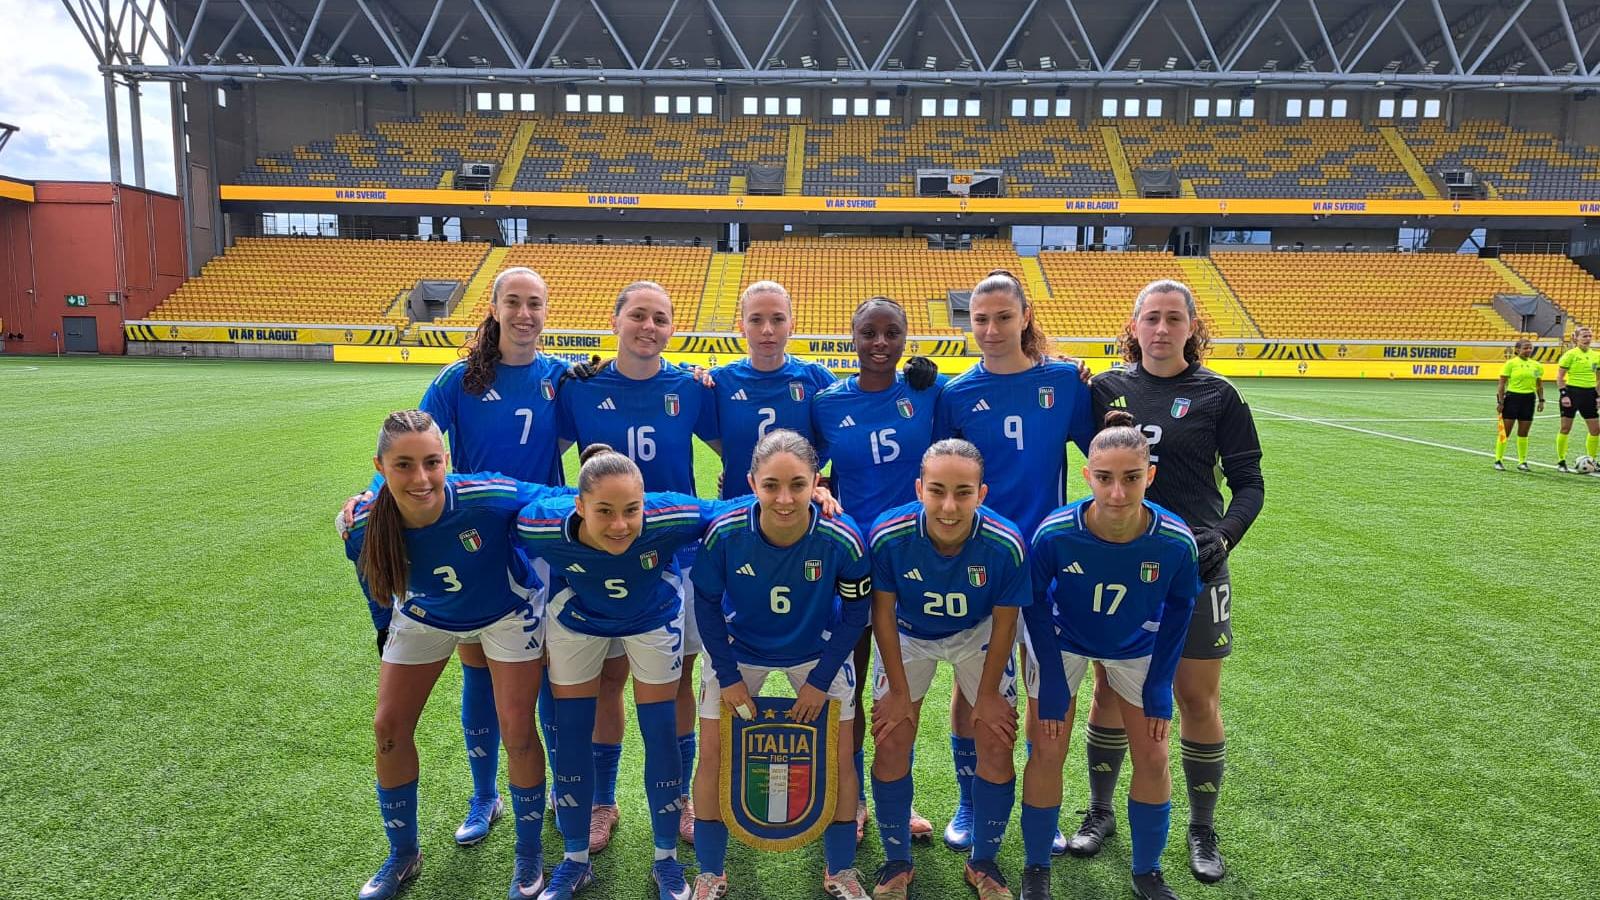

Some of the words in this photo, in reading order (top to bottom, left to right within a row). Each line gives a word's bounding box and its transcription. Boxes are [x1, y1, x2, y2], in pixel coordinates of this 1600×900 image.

[356, 190, 387, 200] SVERIGE
[846, 199, 877, 209] SVERIGE
[1334, 202, 1366, 211] SVERIGE
[228, 328, 239, 340] VI
[557, 336, 601, 348] SVERIGE!
[809, 341, 819, 352] VI
[1104, 344, 1114, 355] VI
[1383, 346, 1408, 358] HEJA
[1410, 347, 1457, 359] SVERIGE!
[1413, 364, 1422, 375] VI
[514, 408, 533, 445] 7
[757, 407, 776, 442] 2
[1003, 415, 1024, 450] 9
[627, 425, 656, 462] 16
[870, 428, 901, 465] 15
[433, 565, 463, 592] 3
[604, 578, 629, 599] 5
[770, 586, 792, 614] 6
[923, 591, 968, 617] 20
[1092, 583, 1128, 615] 17
[1210, 584, 1230, 623] 12
[515, 601, 540, 632] 3
[748, 733, 810, 754] ITALIA
[769, 754, 789, 764] FIGC
